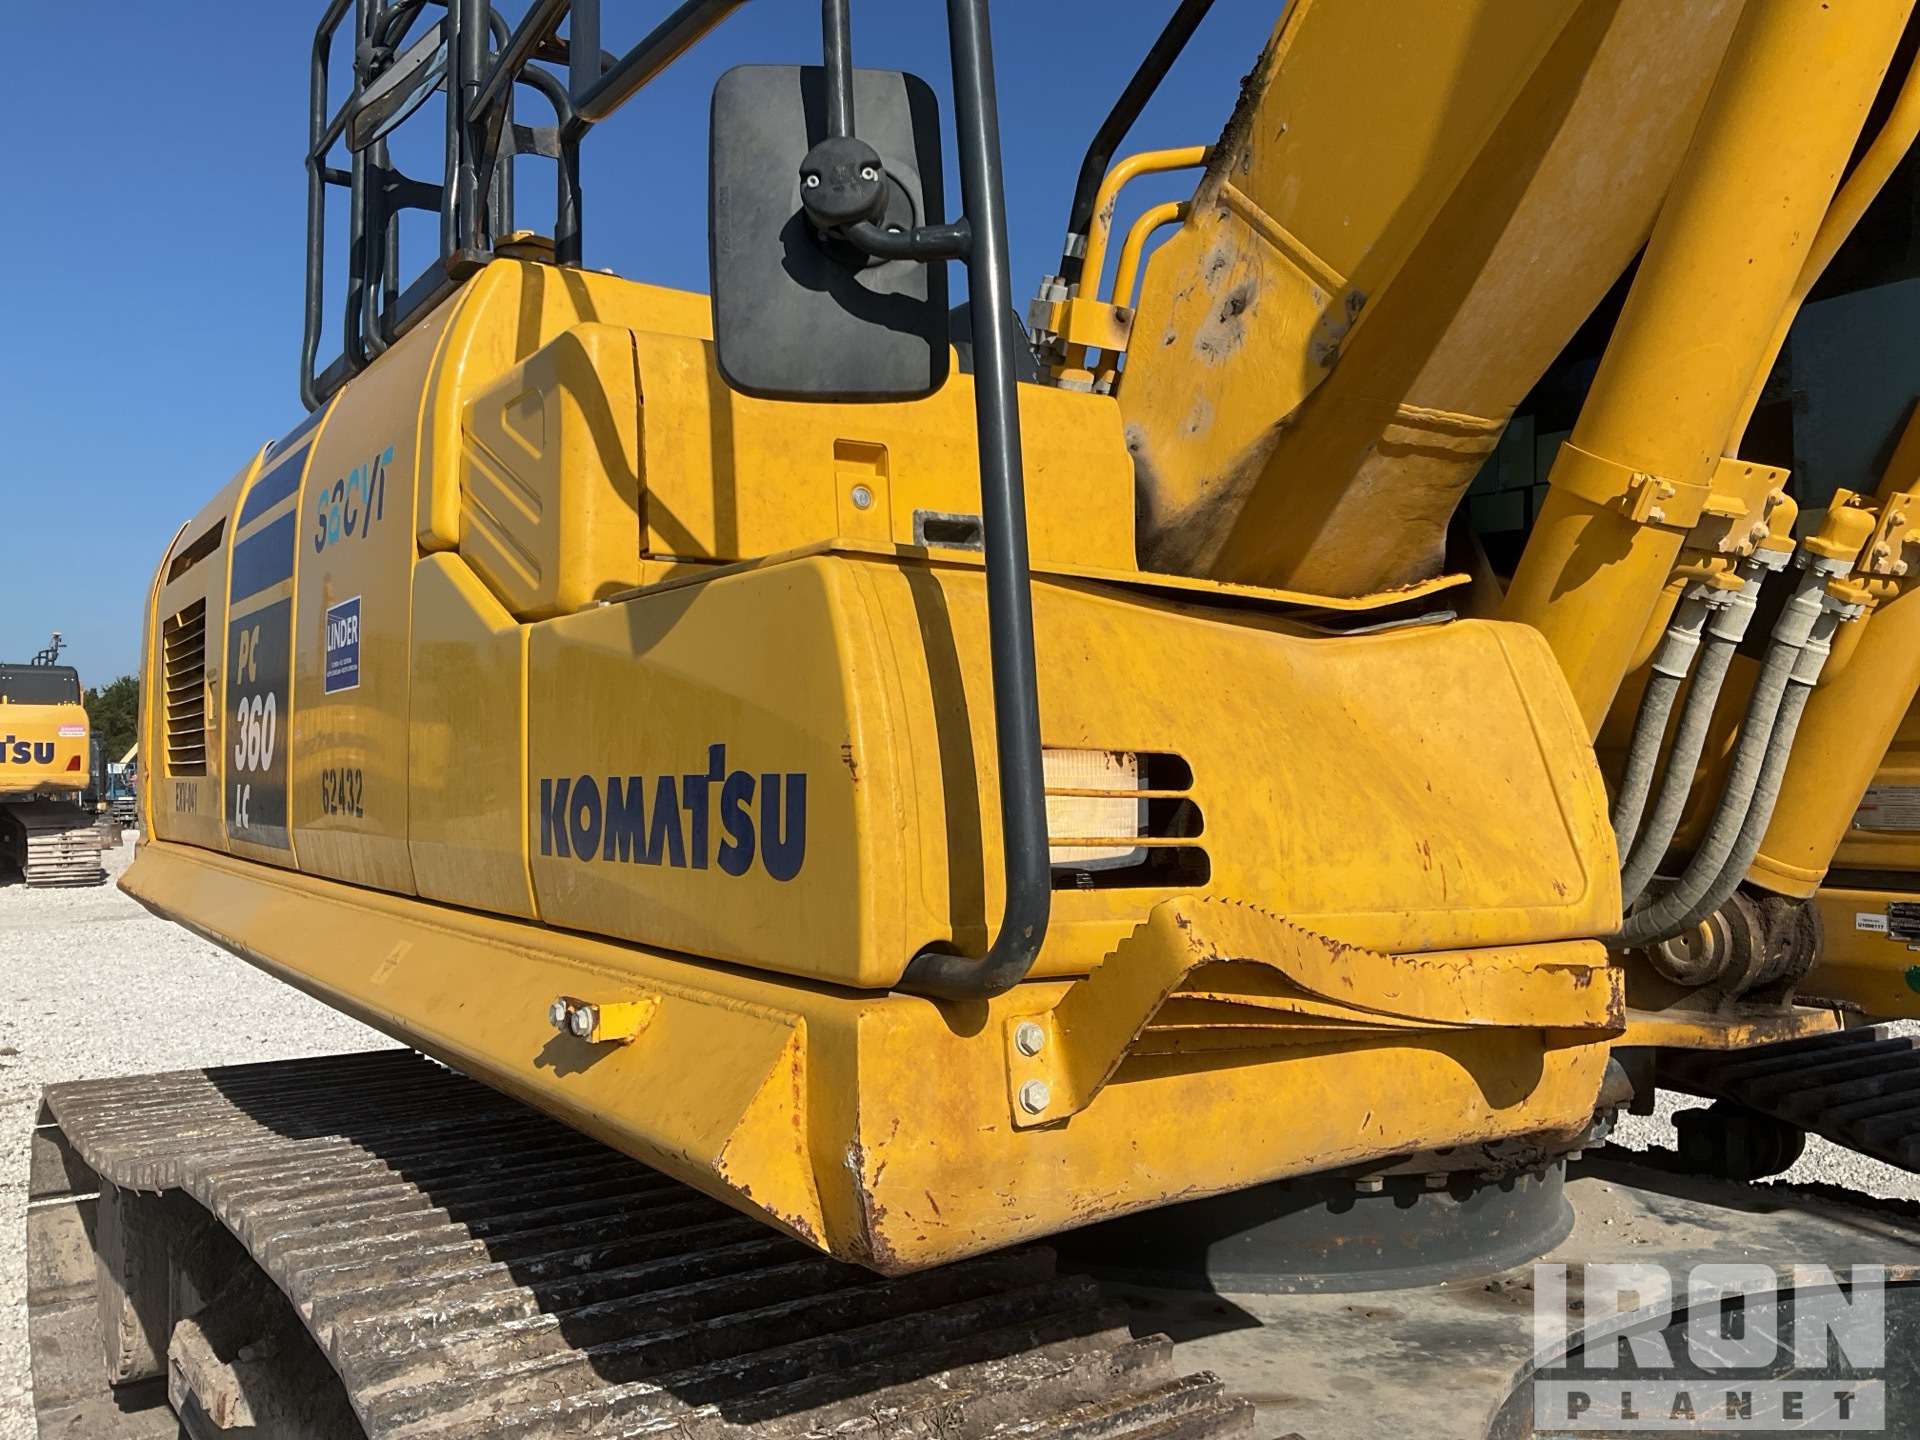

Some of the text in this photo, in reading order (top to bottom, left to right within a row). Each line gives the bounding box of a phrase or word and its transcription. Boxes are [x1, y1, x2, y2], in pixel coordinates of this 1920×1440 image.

[236, 624, 260, 685] PC
[327, 615, 358, 652] LINDER
[234, 691, 277, 772] 360
[235, 784, 250, 829] LC
[322, 767, 364, 818] 62432
[540, 743, 808, 882] KOMATSU
